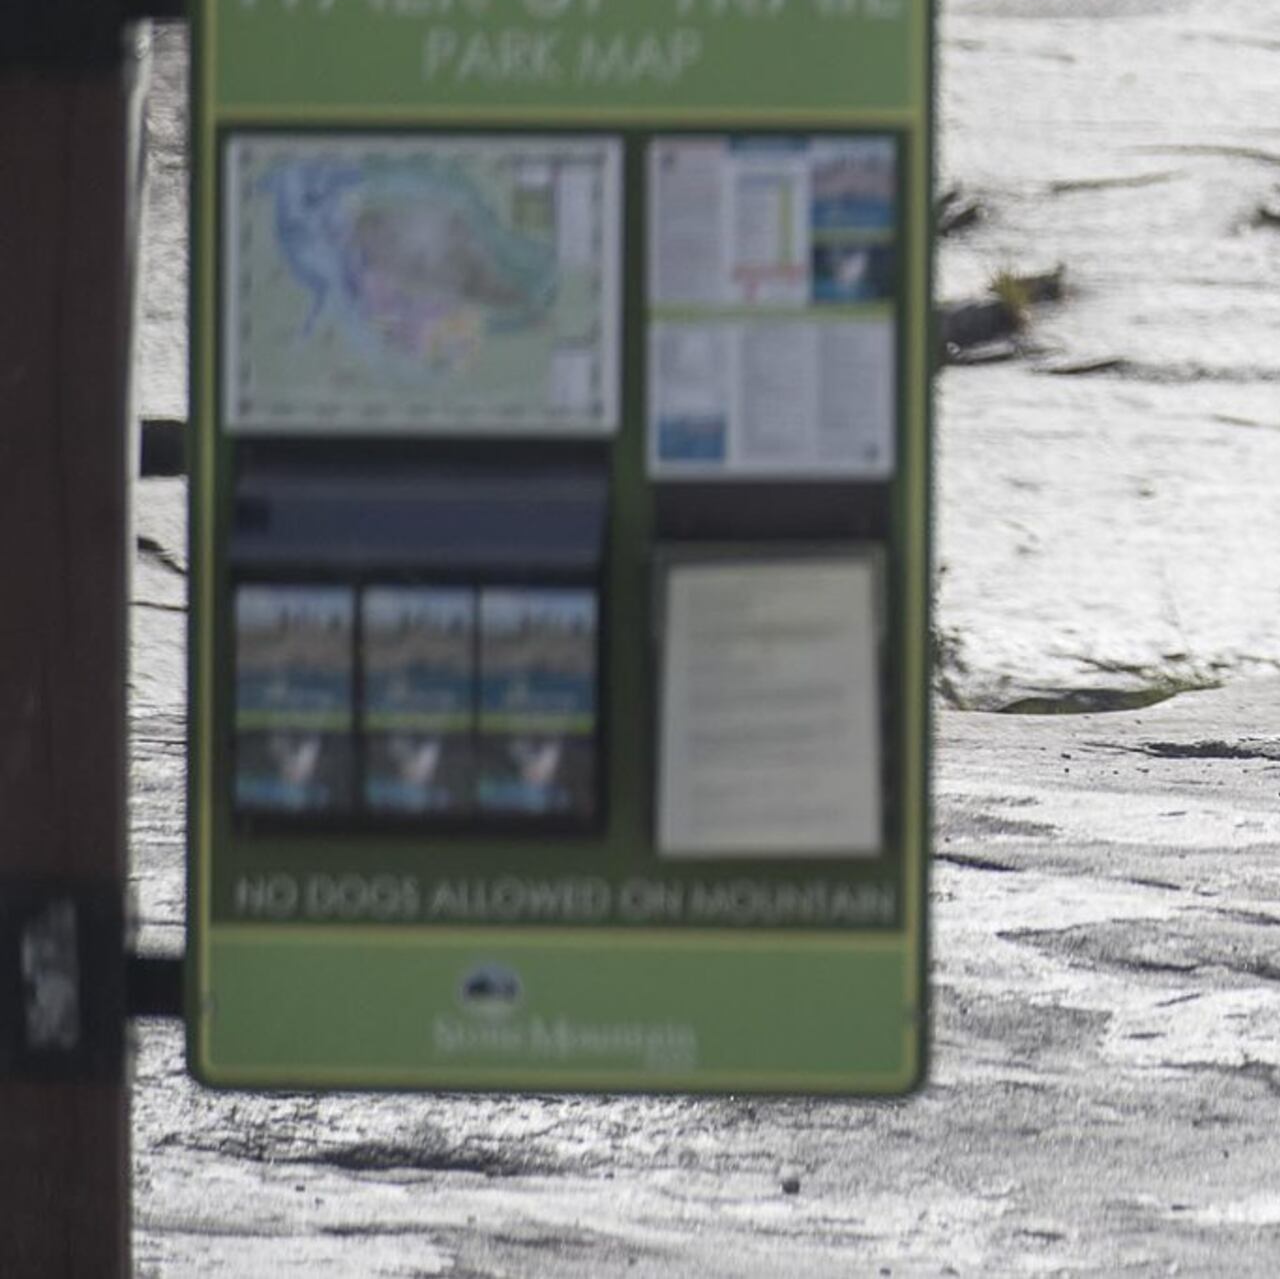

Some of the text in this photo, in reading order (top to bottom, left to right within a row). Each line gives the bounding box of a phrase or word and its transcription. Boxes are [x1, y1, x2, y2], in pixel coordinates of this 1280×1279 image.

[420, 28, 702, 83] PARK MAP
[236, 874, 897, 920] NO DOGS ALLOWED ON MOUNTAIN
